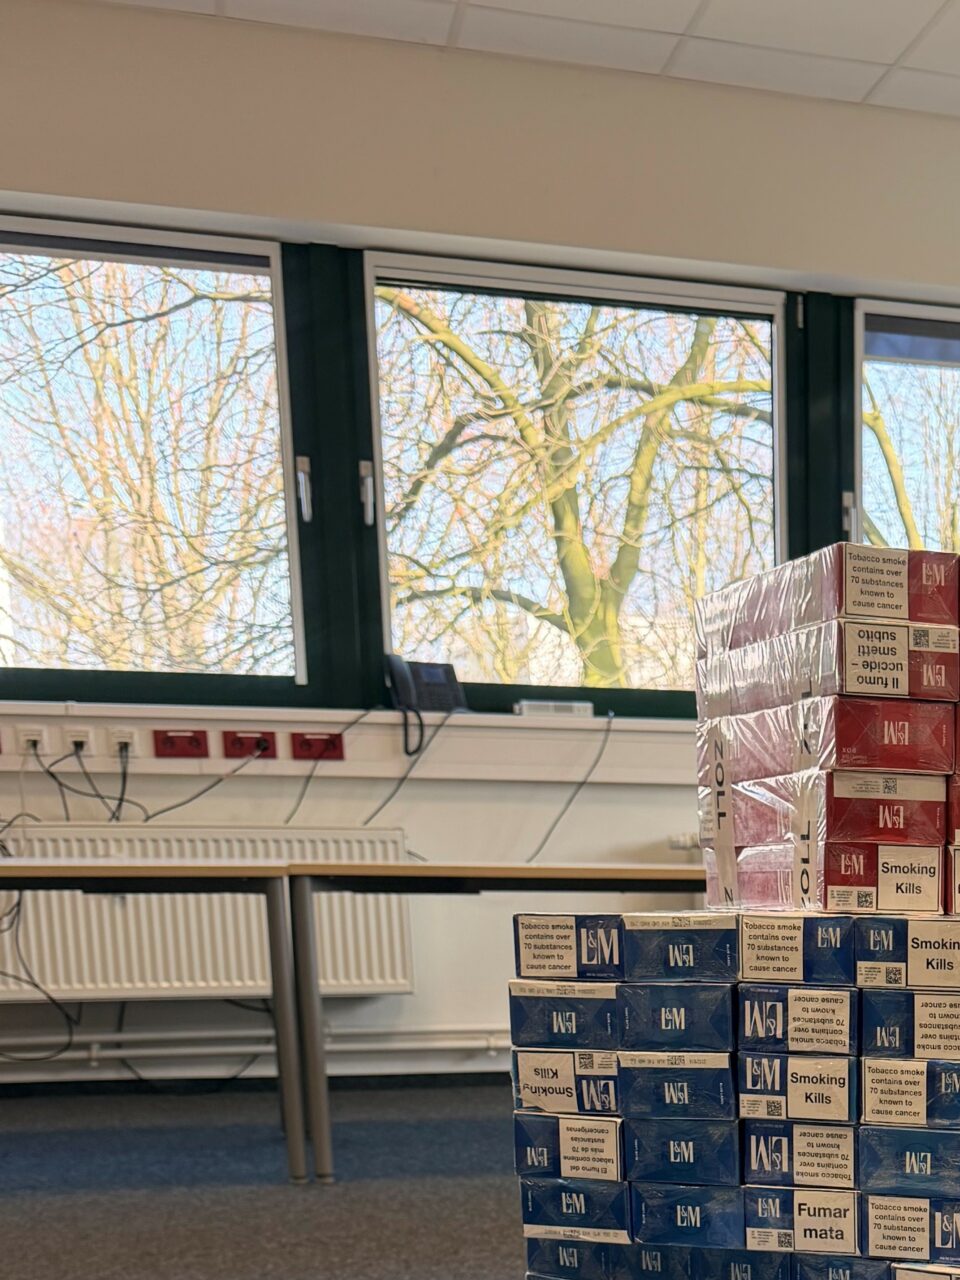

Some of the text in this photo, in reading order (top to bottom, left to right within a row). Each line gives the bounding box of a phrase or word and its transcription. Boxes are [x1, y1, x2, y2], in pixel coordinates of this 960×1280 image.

[848, 553, 906, 565] Tobacco smoke
[853, 565, 885, 576] contains
[922, 562, 945, 587] L&M
[851, 576, 904, 588] 70 substances
[860, 589, 880, 598] known
[853, 599, 902, 610] cause cancer
[858, 630, 896, 641] subito
[858, 645, 897, 656] smetti
[862, 660, 903, 672] uccide
[857, 675, 899, 688] Il fumo
[713, 740, 726, 830] ZOLL
[881, 862, 936, 877] Smoking
[896, 882, 922, 894] Kills
[581, 928, 619, 965] L&M
[926, 959, 954, 970] Kills
[744, 1001, 783, 1038] L&M
[798, 1203, 850, 1219] Fumar
[804, 1227, 844, 1241] mata
